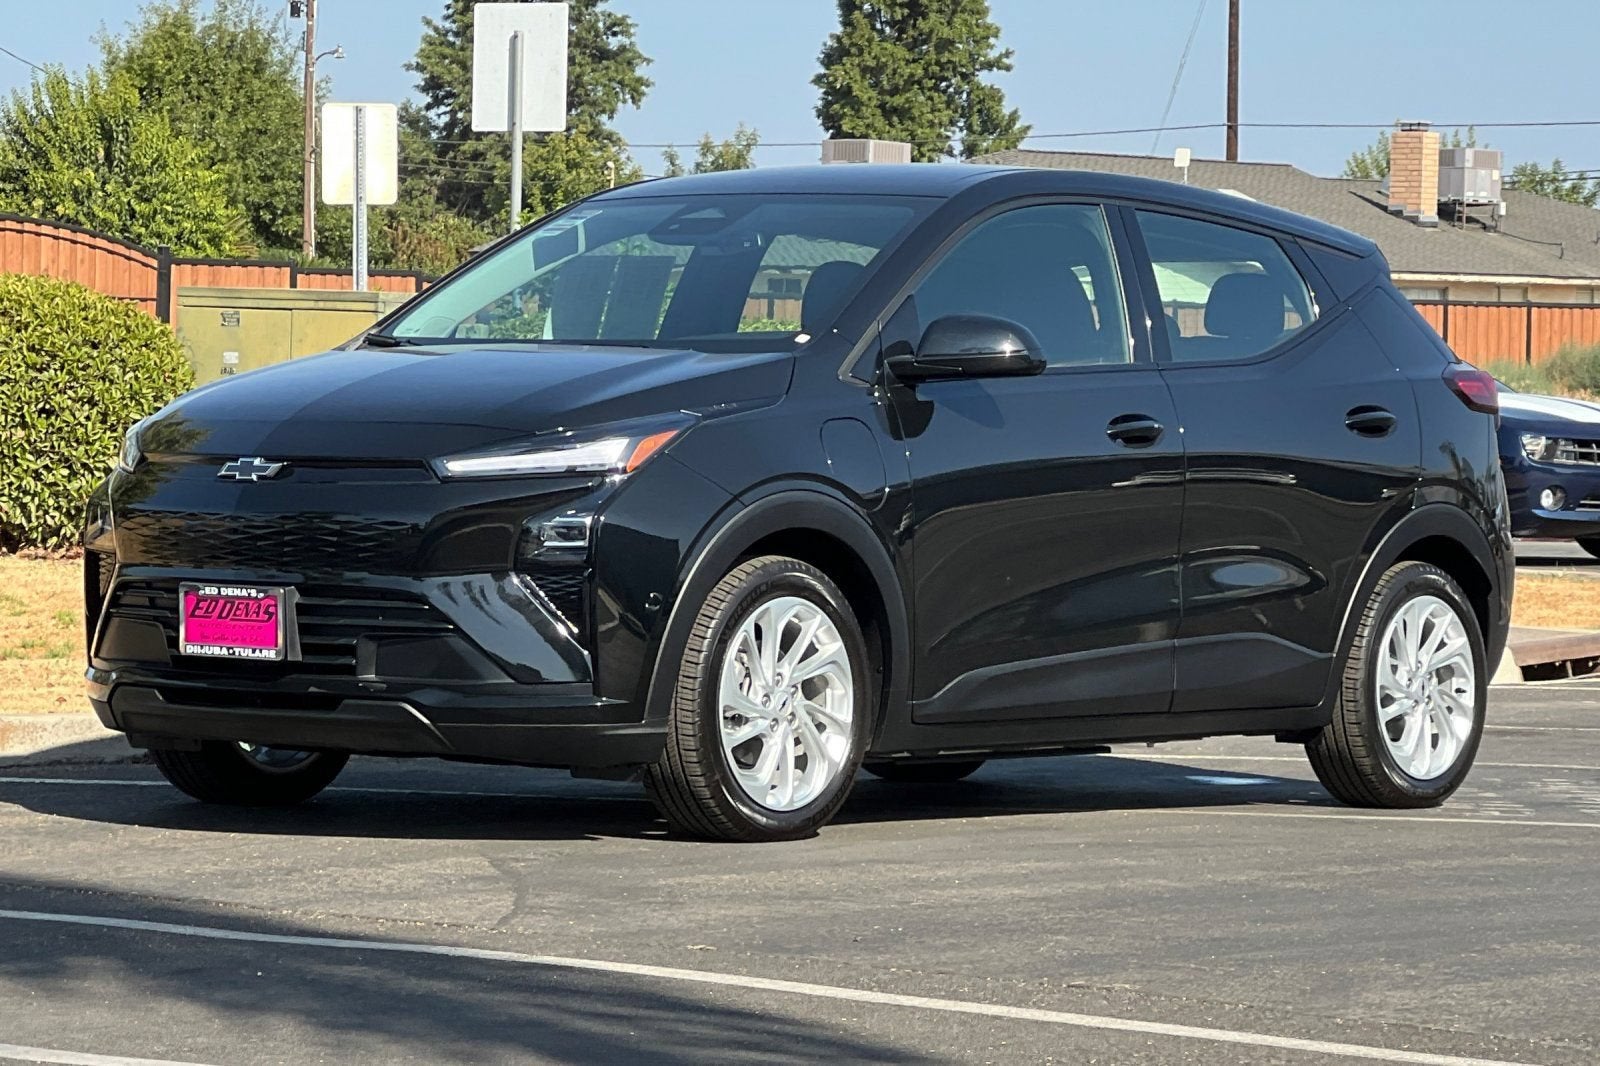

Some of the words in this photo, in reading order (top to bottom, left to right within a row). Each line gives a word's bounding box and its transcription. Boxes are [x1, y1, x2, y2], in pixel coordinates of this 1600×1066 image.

[205, 587, 219, 595] ED
[220, 587, 257, 597] DENA'S
[190, 598, 219, 619] ED
[234, 648, 277, 658] TULARE
